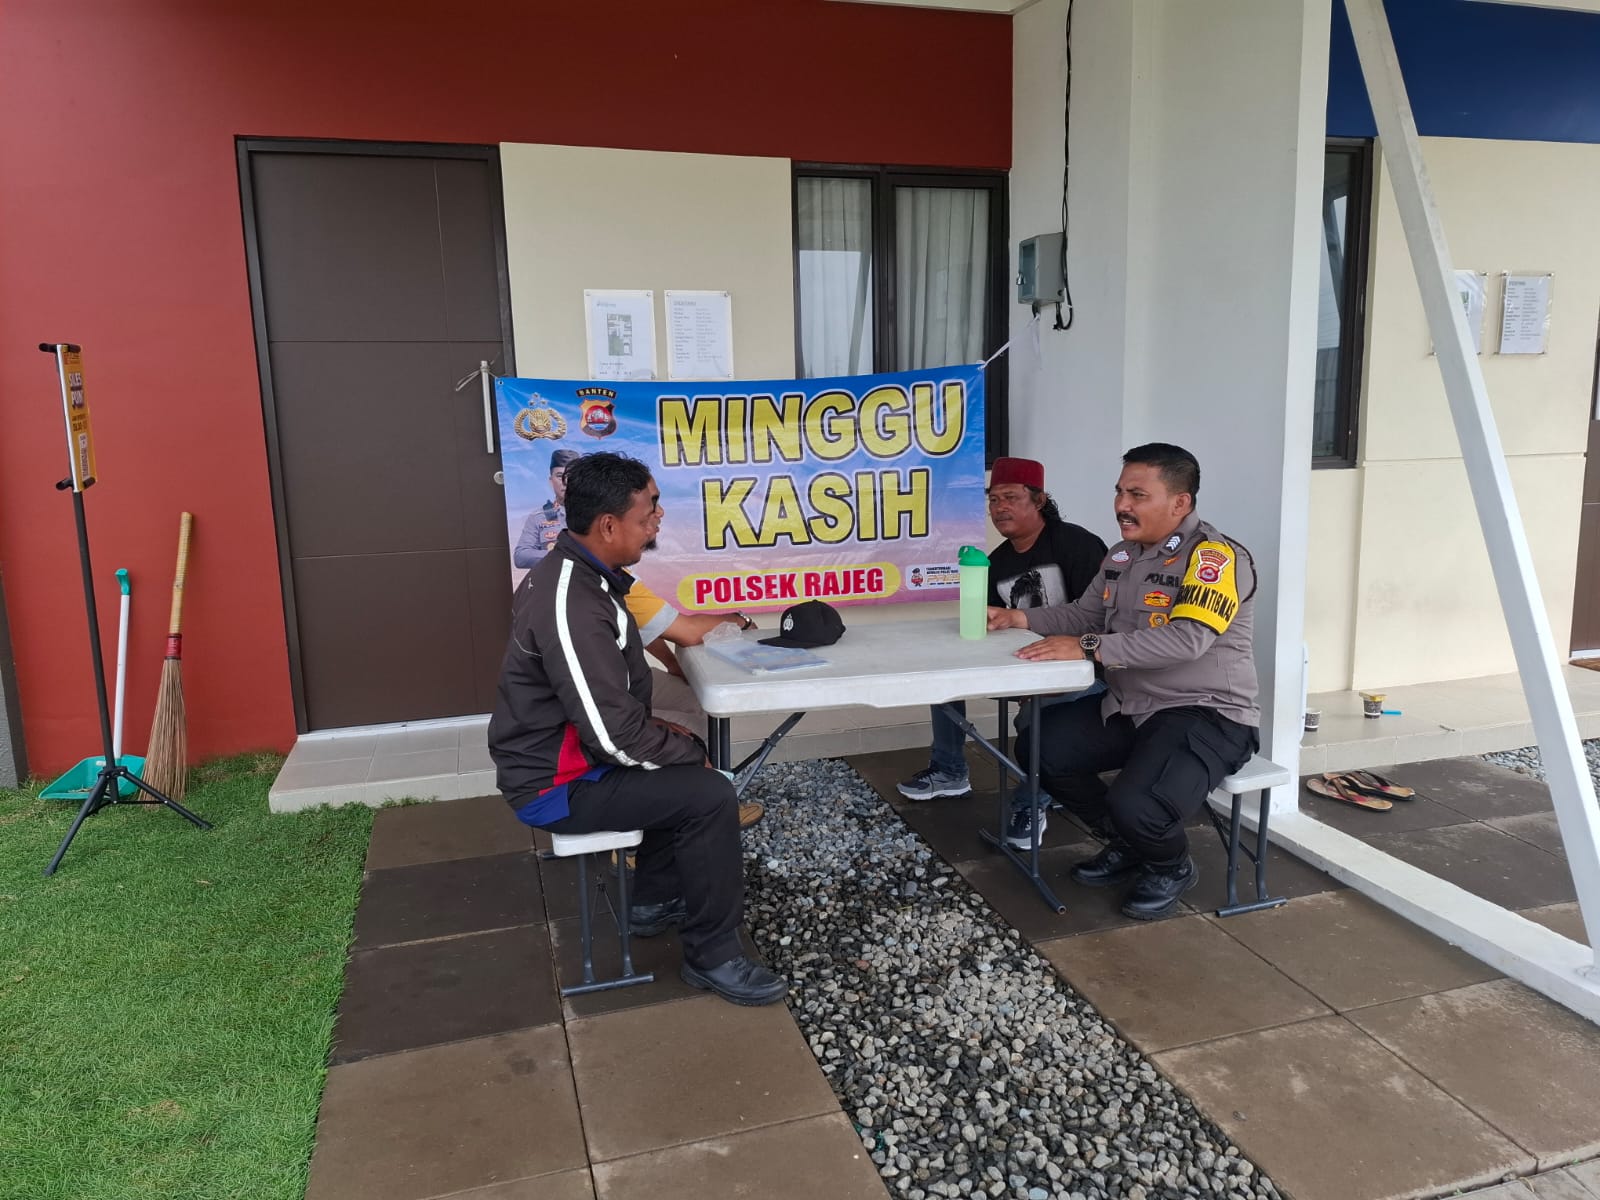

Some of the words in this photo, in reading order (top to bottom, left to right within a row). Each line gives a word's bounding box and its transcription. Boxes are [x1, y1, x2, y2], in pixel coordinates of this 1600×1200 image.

[578, 388, 615, 397] BANTEN
[658, 381, 965, 466] MINGGU
[702, 468, 931, 549] KASIH
[695, 575, 798, 604] POLSEK
[803, 567, 884, 597] RAJEG
